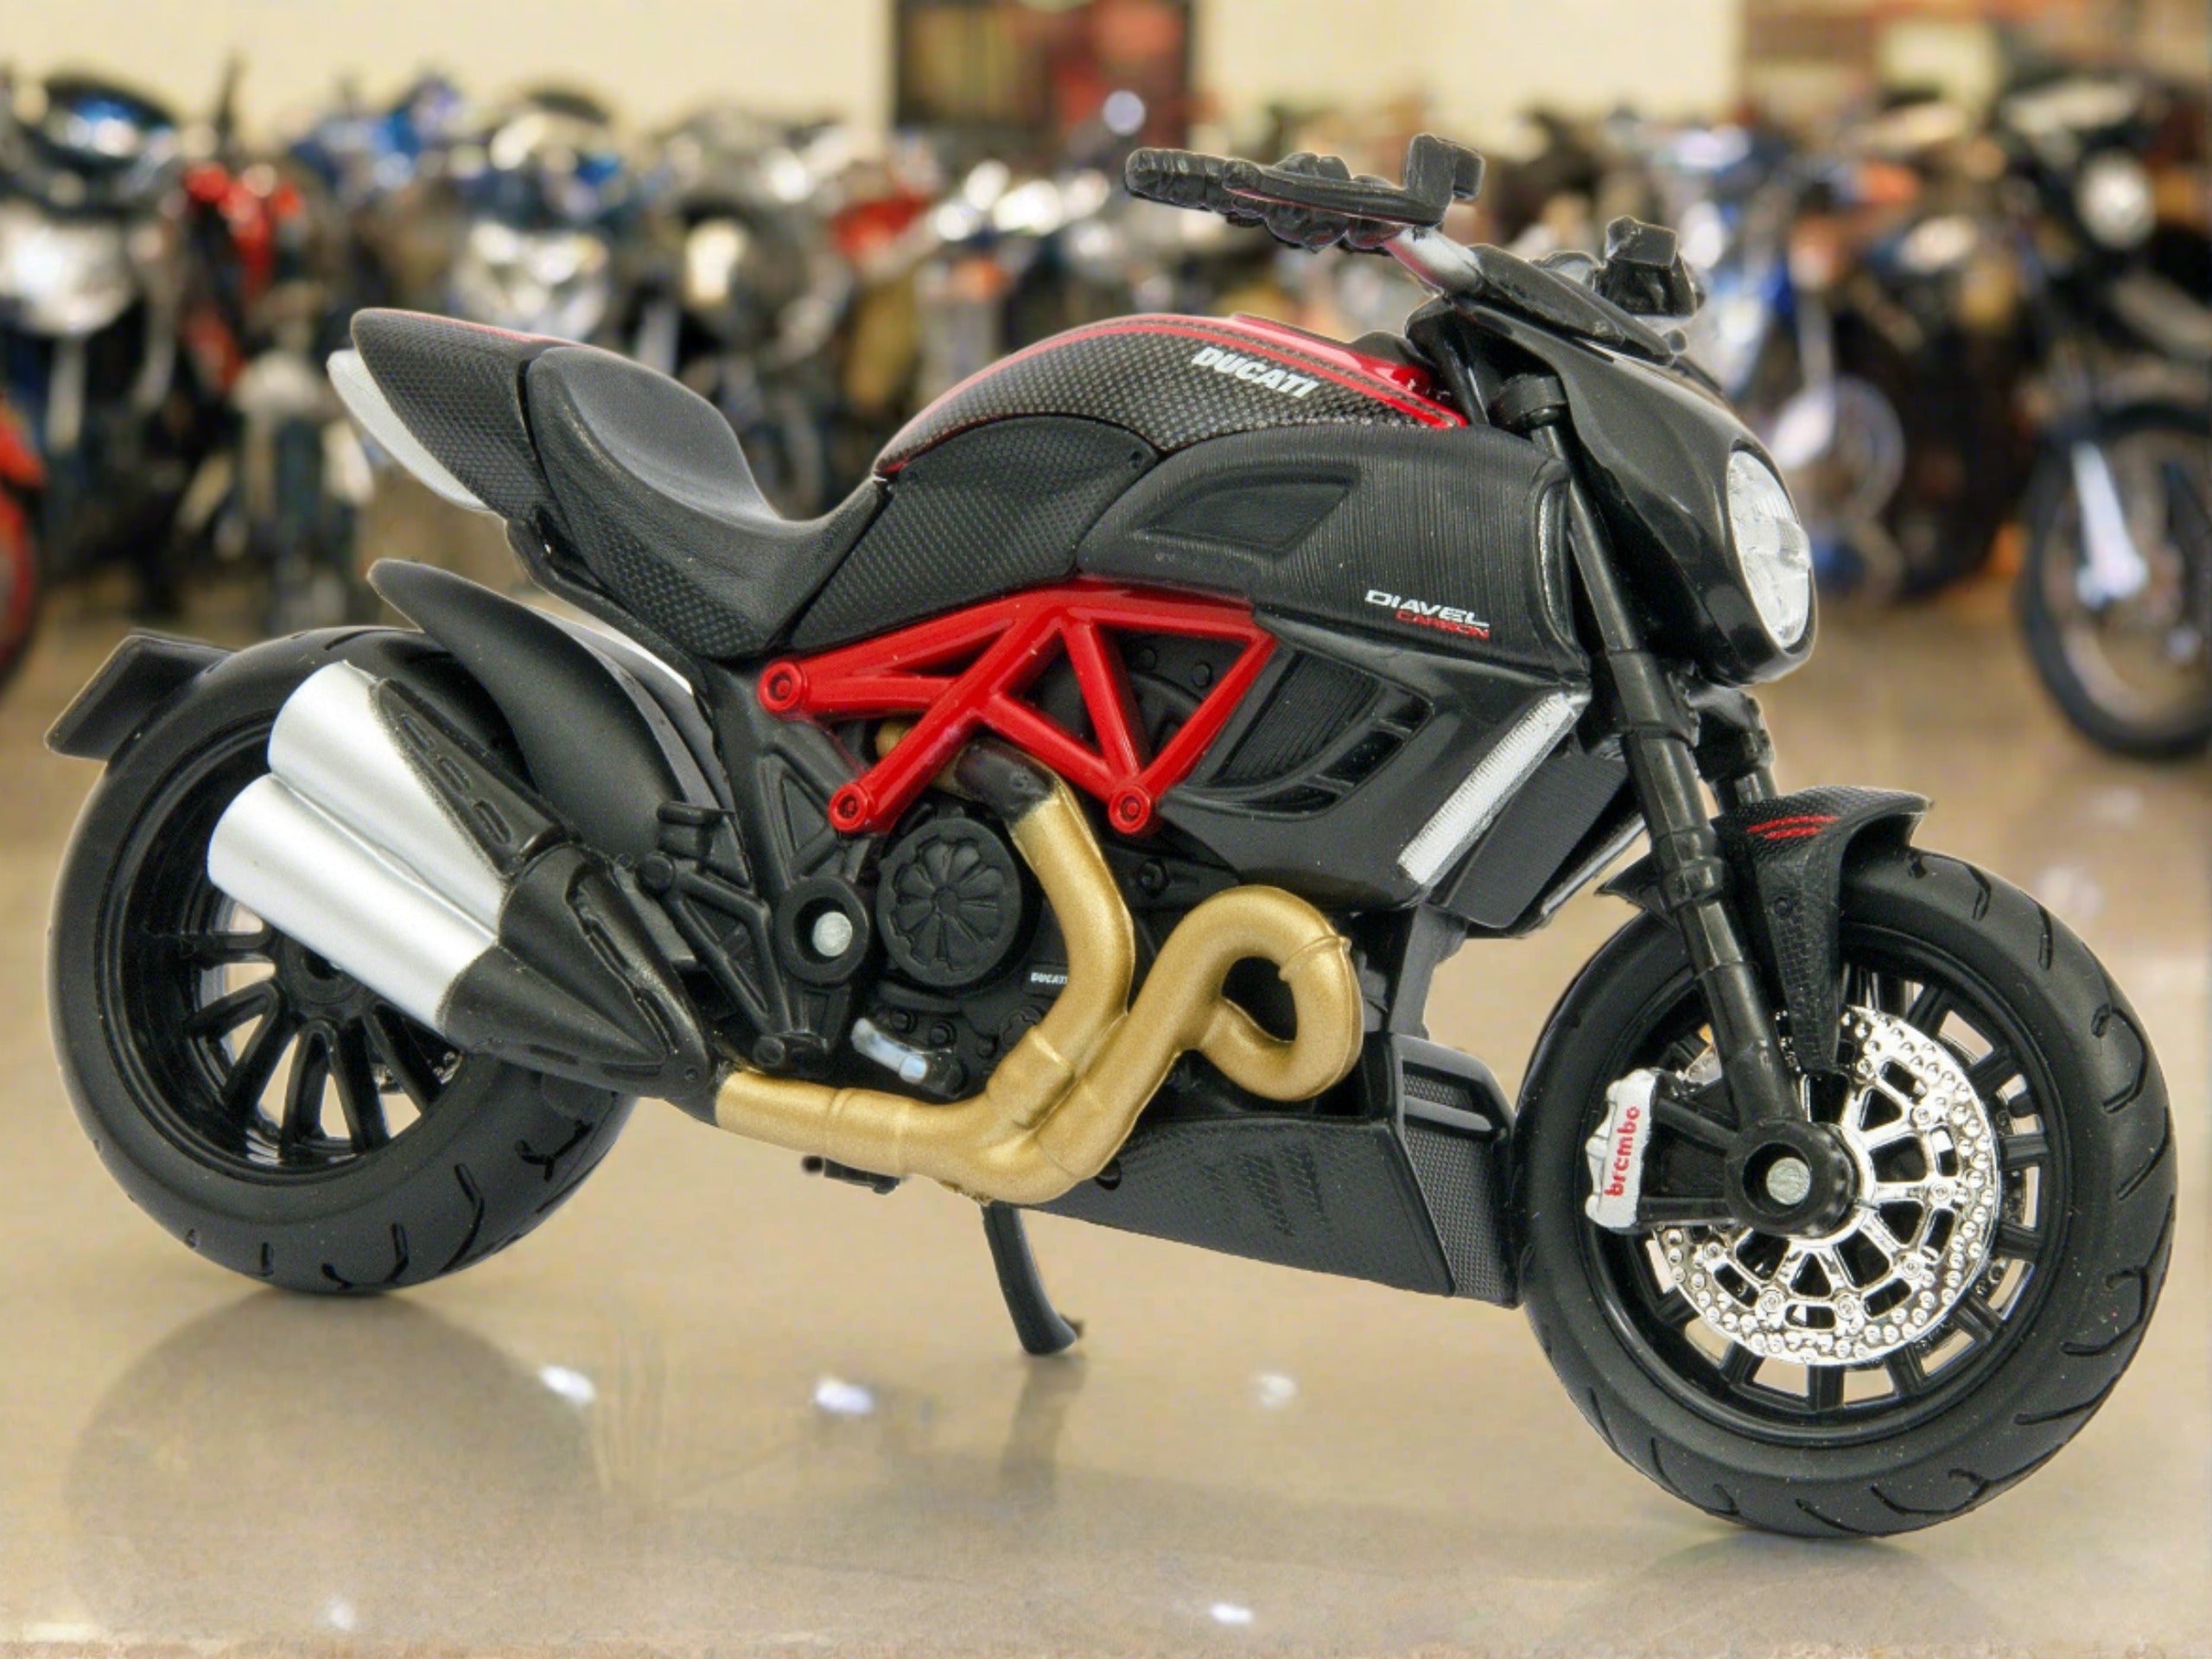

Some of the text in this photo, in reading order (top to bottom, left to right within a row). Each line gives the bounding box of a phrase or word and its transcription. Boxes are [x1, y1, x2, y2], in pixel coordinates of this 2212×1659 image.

[1191, 346, 1319, 397] DUCATI
[1364, 589, 1490, 628] DIAVEL
[1604, 1106, 1640, 1196] brembo
